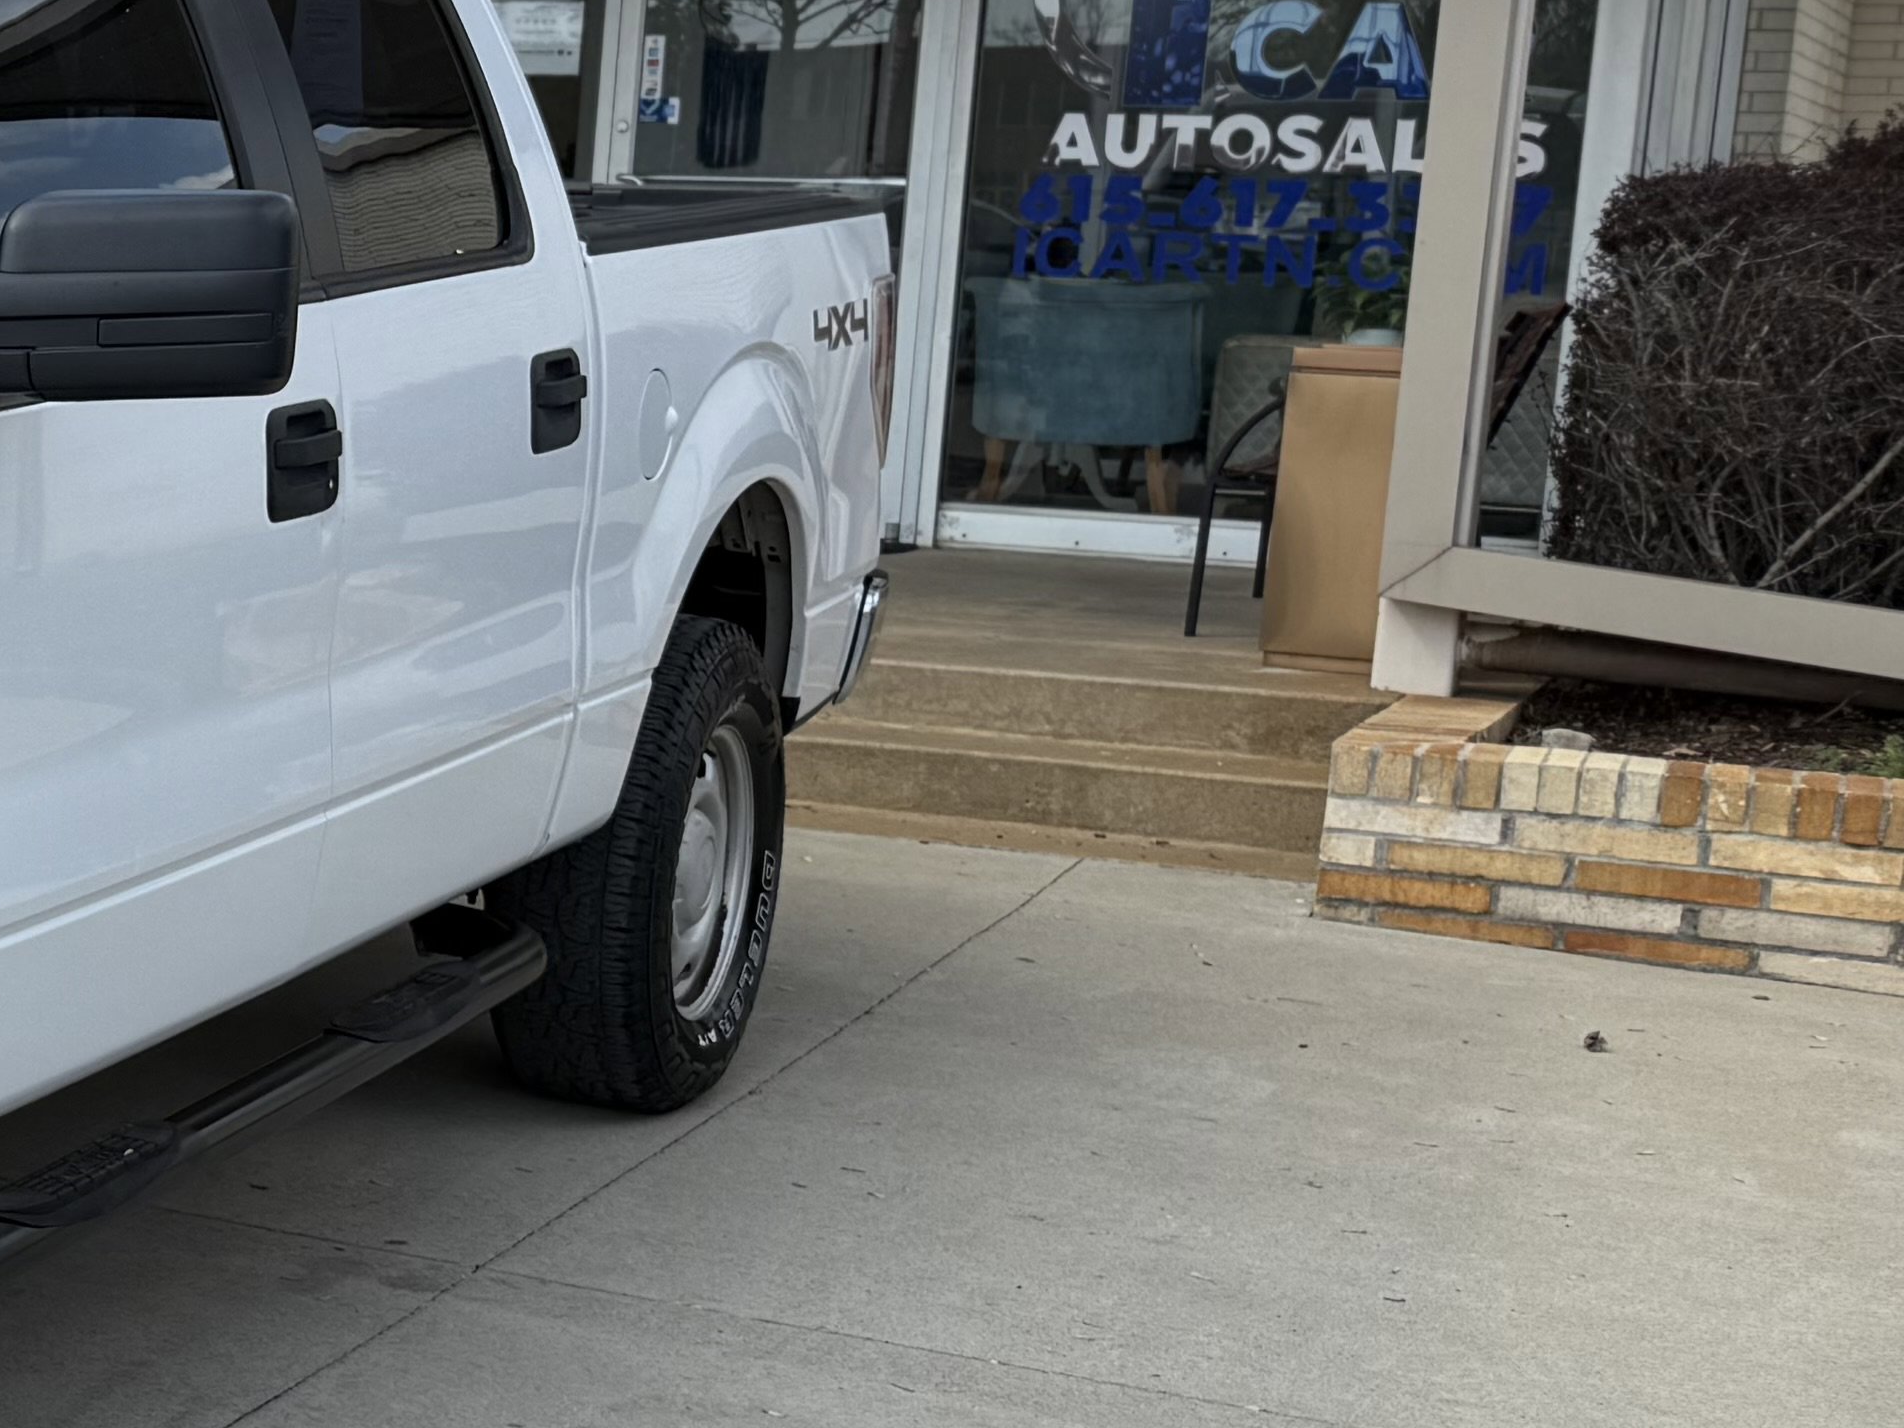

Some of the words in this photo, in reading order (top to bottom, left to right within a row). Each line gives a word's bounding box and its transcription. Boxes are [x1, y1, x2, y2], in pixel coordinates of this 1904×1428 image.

[1043, 113, 1549, 178] AUTOSALS
[1012, 228, 1548, 296] ICARTN.CM
[719, 850, 776, 1038] DUELER
